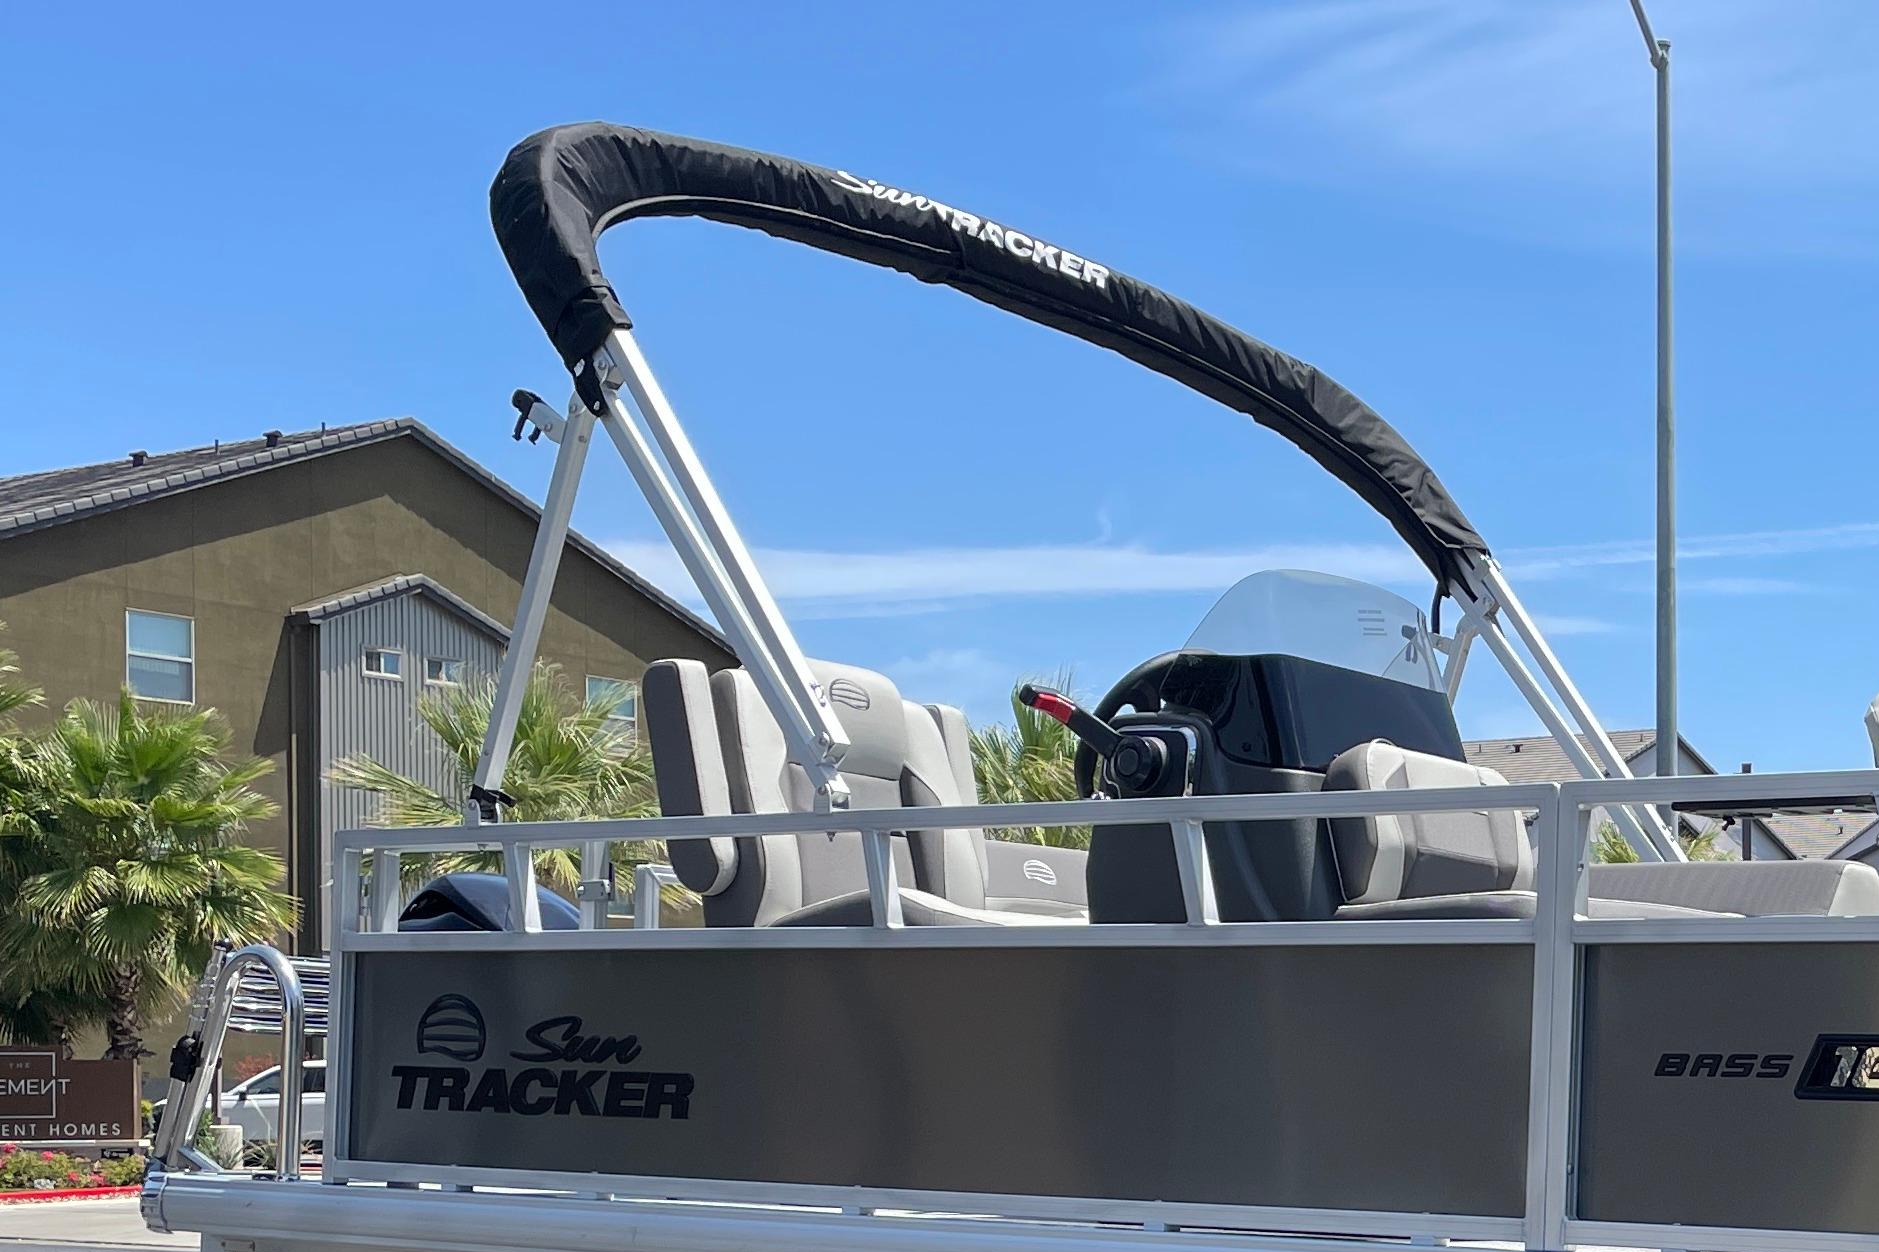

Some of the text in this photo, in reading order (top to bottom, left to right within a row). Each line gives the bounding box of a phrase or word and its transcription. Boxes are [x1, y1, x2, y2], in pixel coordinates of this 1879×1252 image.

[831, 170, 1110, 289] Sun TRACKER
[509, 1016, 643, 1064] Sun
[9, 1062, 30, 1070] THE
[1654, 1053, 1795, 1078] BASS
[391, 1065, 695, 1119] TRACKER
[49, 1122, 121, 1137] HOMES
